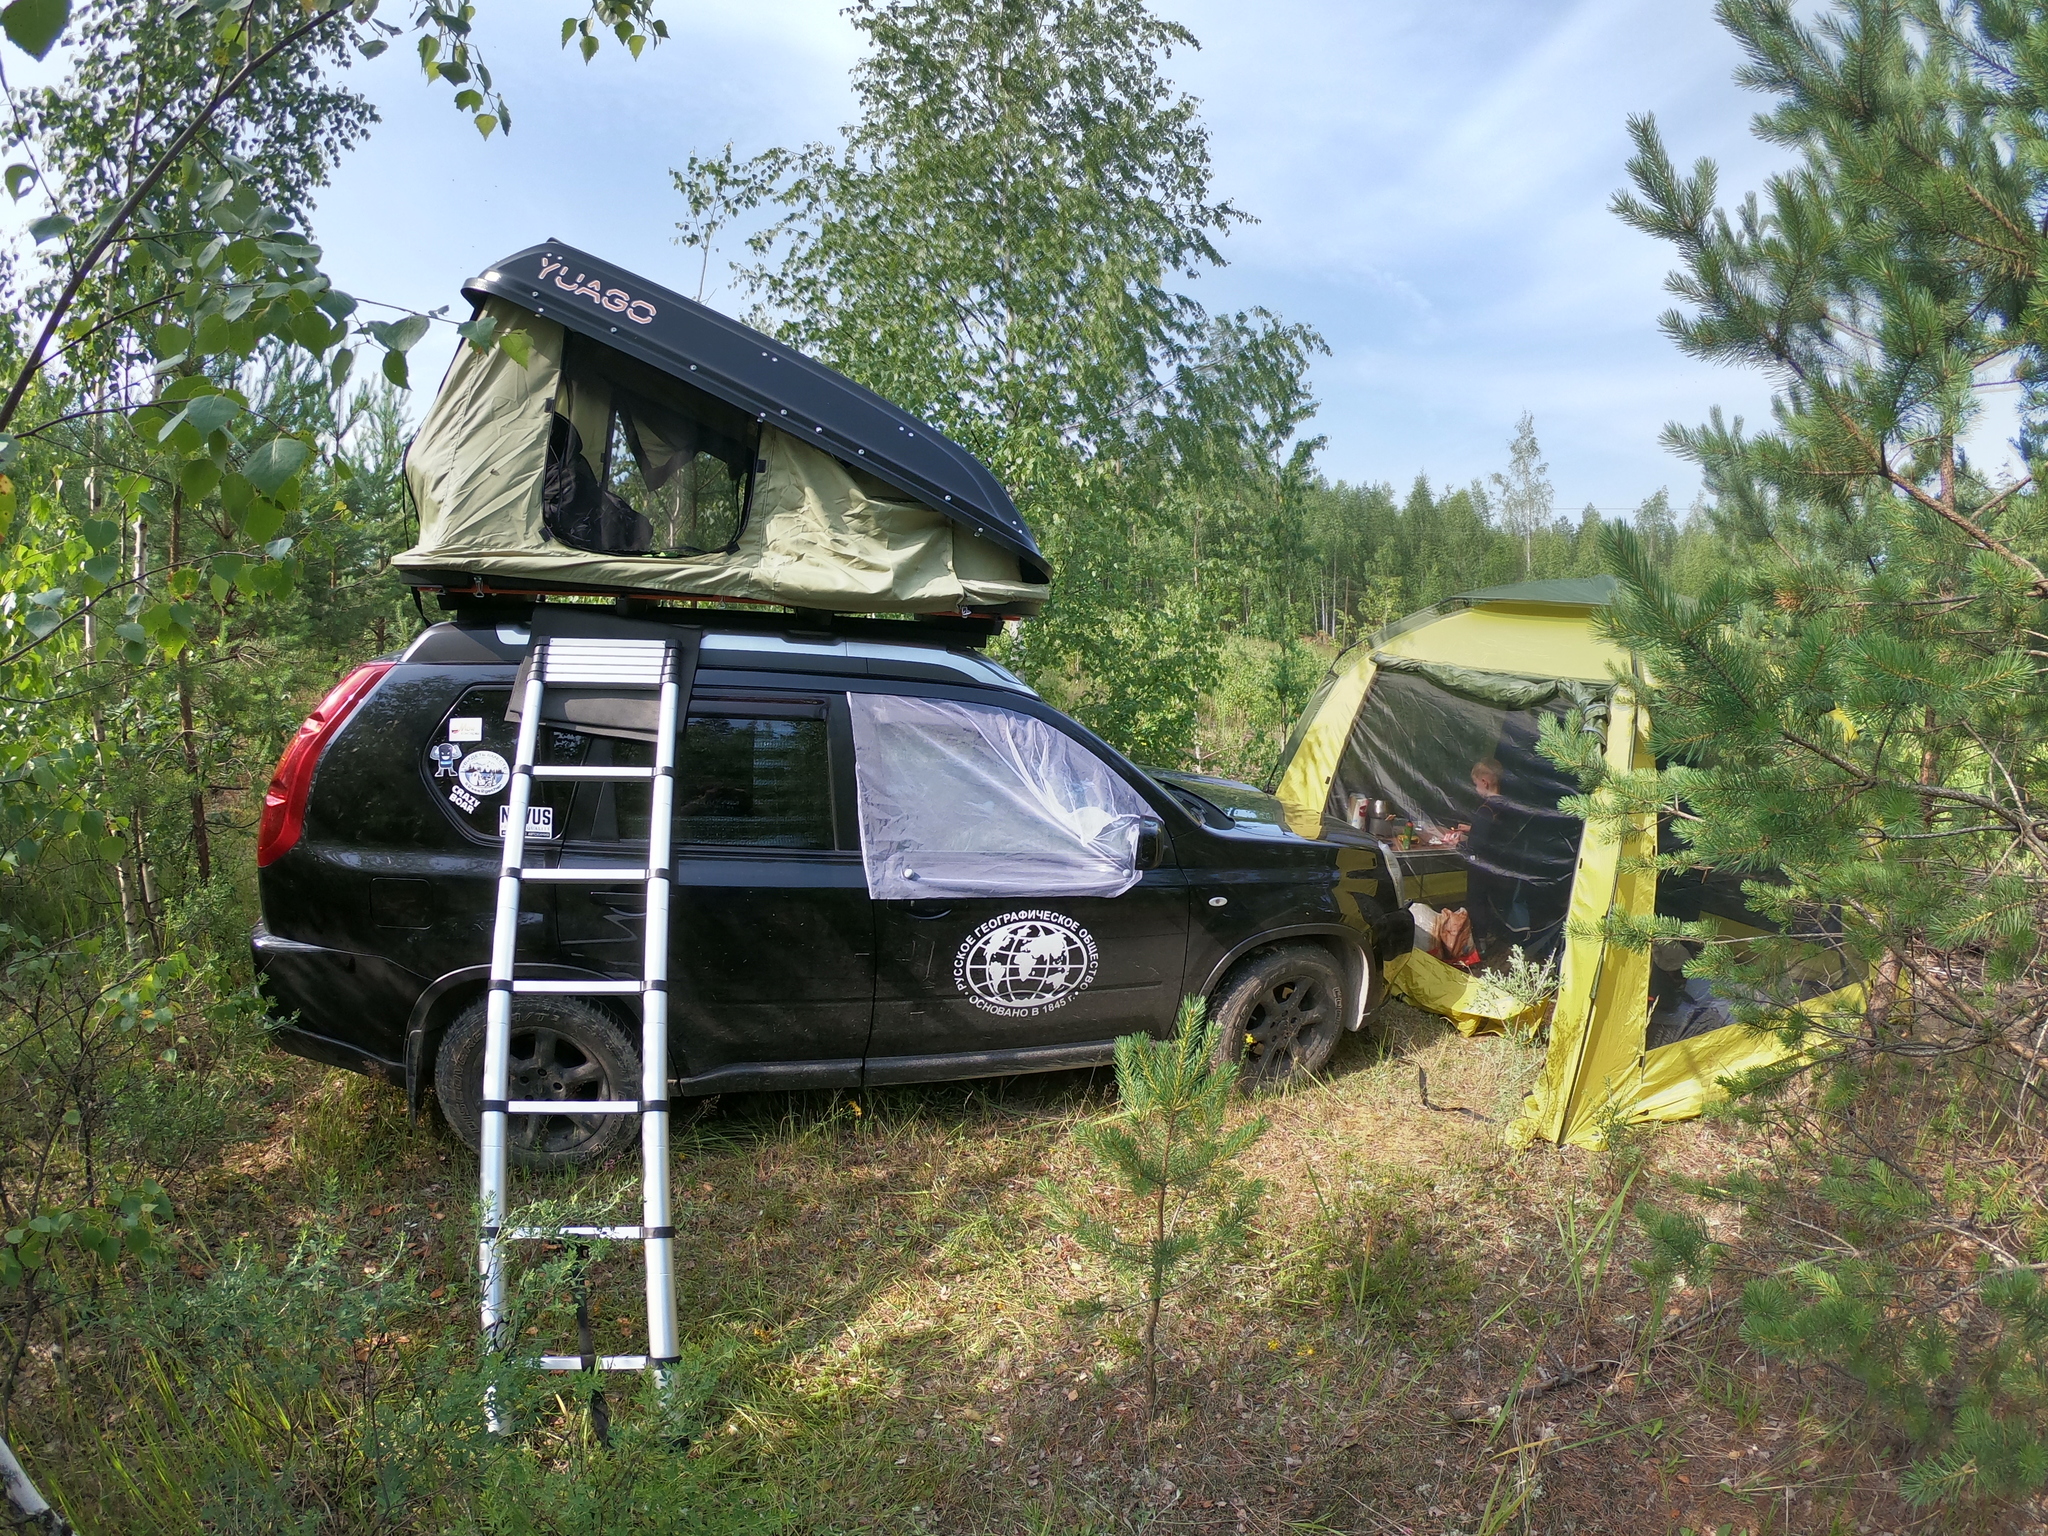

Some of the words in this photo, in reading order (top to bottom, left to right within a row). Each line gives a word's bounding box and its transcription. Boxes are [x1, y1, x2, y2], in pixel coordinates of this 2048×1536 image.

[538, 257, 657, 324] YUAGO
[449, 794, 475, 815] BOAR
[451, 785, 481, 808] CRAZY
[501, 806, 551, 825] NVUS
[953, 935, 977, 992] РУССКОЕ
[974, 909, 1081, 938] ГЕОГРАФИЧЕСКОЕ
[1078, 928, 1099, 991] ОБЩЕСТВО
[969, 994, 1029, 1018] ОСНОВАНО
[1031, 1006, 1040, 1017] В
[1041, 998, 1067, 1015] 1845
[451, 1029, 487, 1134] DISCOVERE
